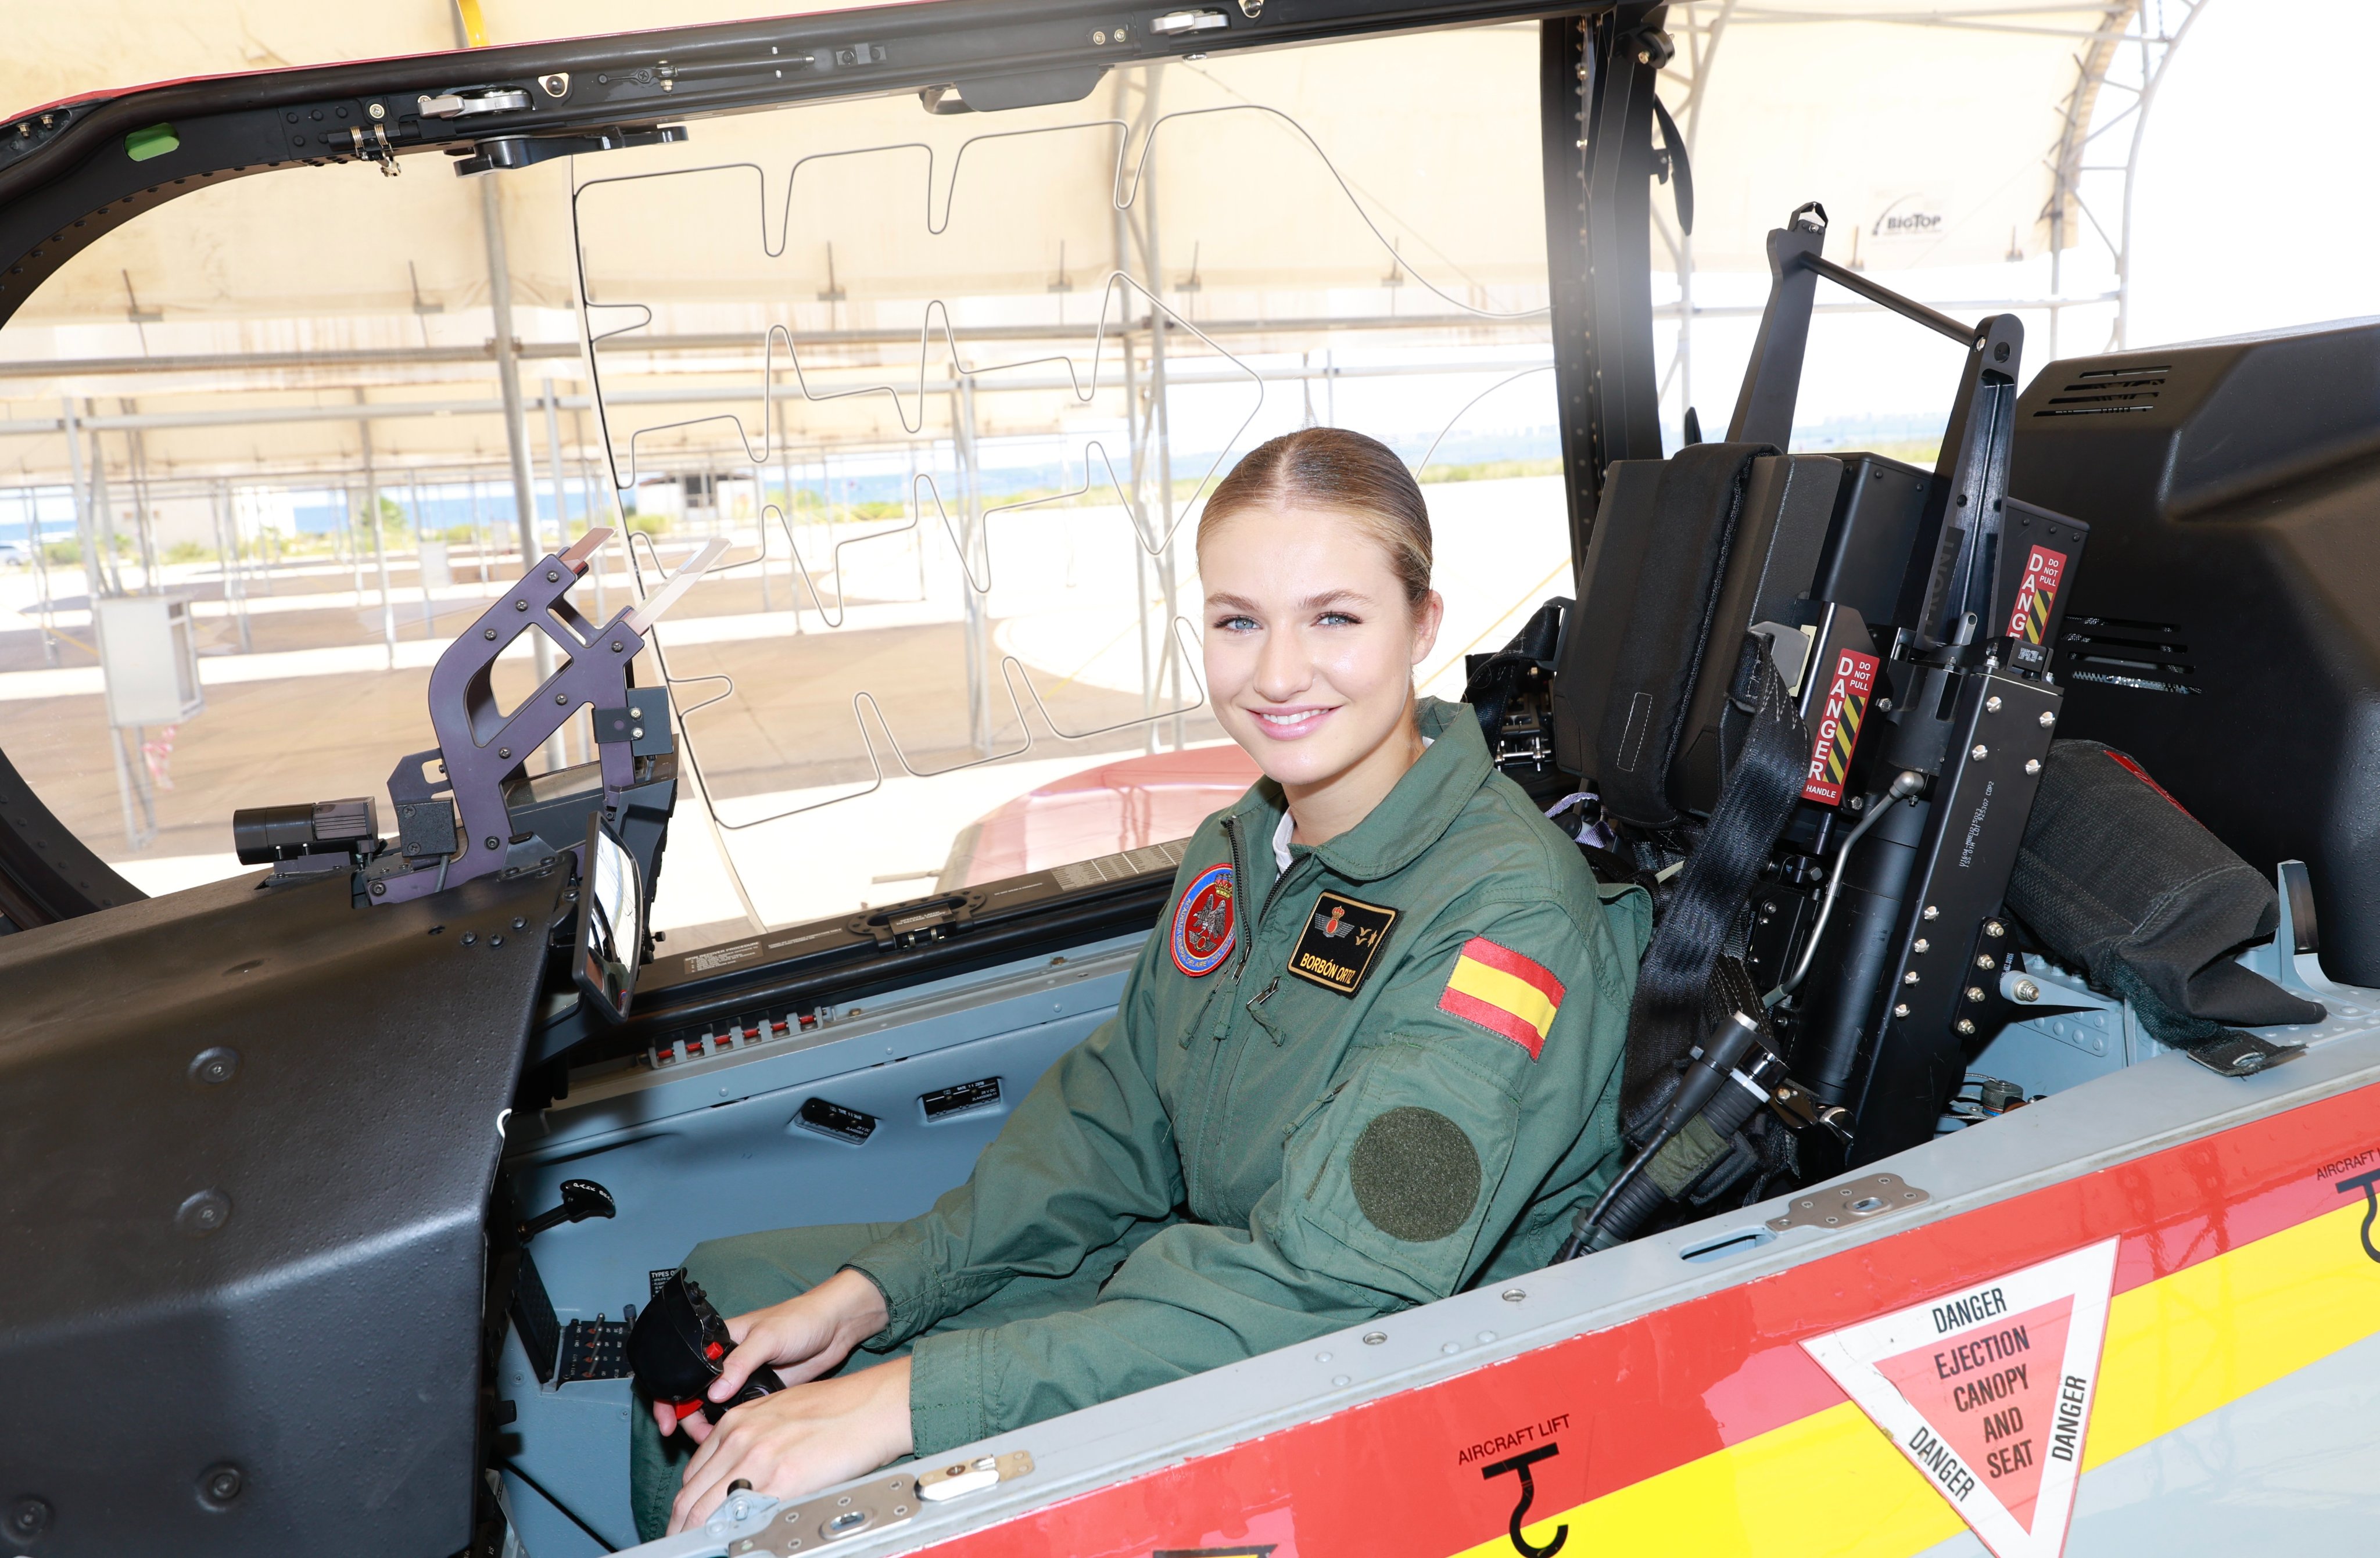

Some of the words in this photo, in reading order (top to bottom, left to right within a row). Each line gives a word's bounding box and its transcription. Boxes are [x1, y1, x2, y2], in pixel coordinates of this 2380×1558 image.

[2044, 567, 2059, 577] NOT
[2048, 558, 2059, 568] DO
[2009, 553, 2043, 638] DANG
[2039, 575, 2056, 587] PULL
[1854, 672, 1870, 681] NOT
[1859, 662, 1871, 670] DO
[1849, 680, 1869, 691] PULL
[1808, 656, 1854, 781] DANGER
[1806, 784, 1837, 799] HANDLE
[699, 949, 725, 958] RECOVER
[726, 941, 759, 952] PROCEDURE
[1300, 953, 1339, 978] BORBÓN
[1336, 967, 1356, 985] ORTIZ
[2317, 1149, 2374, 1181] AIRCRAFT
[573, 1183, 596, 1191] PARK
[1931, 1287, 2008, 1334] DANGER
[1933, 1324, 2031, 1380] EJECTION
[1953, 1363, 2029, 1413] CANOPY
[1983, 1406, 2024, 1444] AND
[2052, 1374, 2087, 1462] DANGER
[1458, 1426, 1534, 1466] AIRCRAFT
[1537, 1413, 1569, 1437] LIFT
[1908, 1426, 1976, 1503] DANGER
[1987, 1439, 2034, 1480] SEAT
